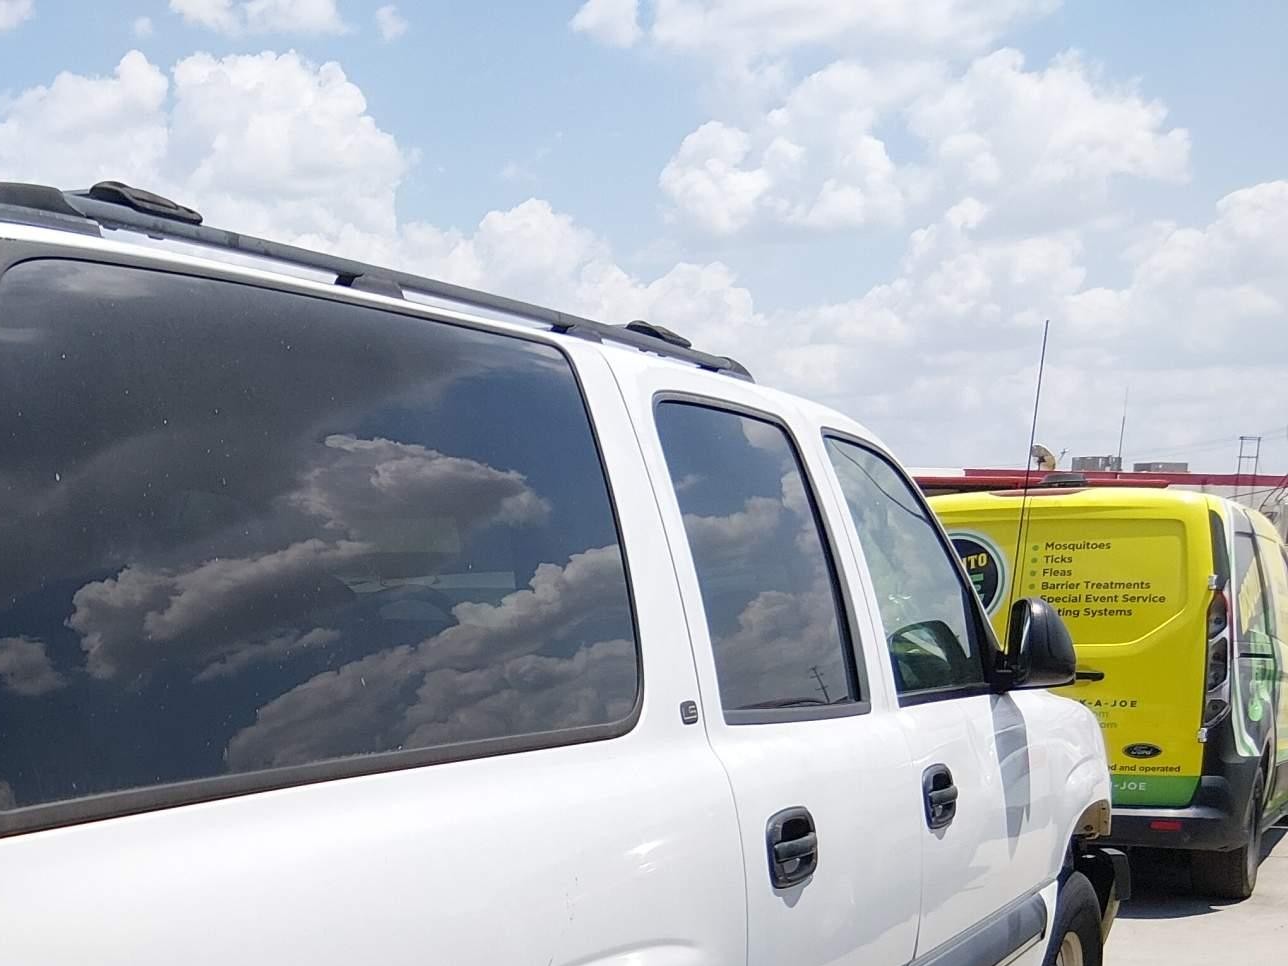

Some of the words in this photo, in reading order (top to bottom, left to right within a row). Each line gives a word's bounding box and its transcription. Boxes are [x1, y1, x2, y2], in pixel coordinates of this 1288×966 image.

[1044, 541, 1112, 552] Mosquitoes
[1043, 555, 1073, 564] Ticks
[1042, 568, 1073, 577] Fleas
[1041, 581, 1080, 590] Barrier
[1083, 580, 1151, 590] Treatments
[1039, 594, 1082, 604] Special
[1084, 593, 1119, 603] Event
[1121, 593, 1167, 603] Service
[1057, 607, 1080, 618] ting
[1083, 607, 1133, 618] Systems
[1119, 764, 1137, 772] and
[1138, 764, 1181, 773] operated
